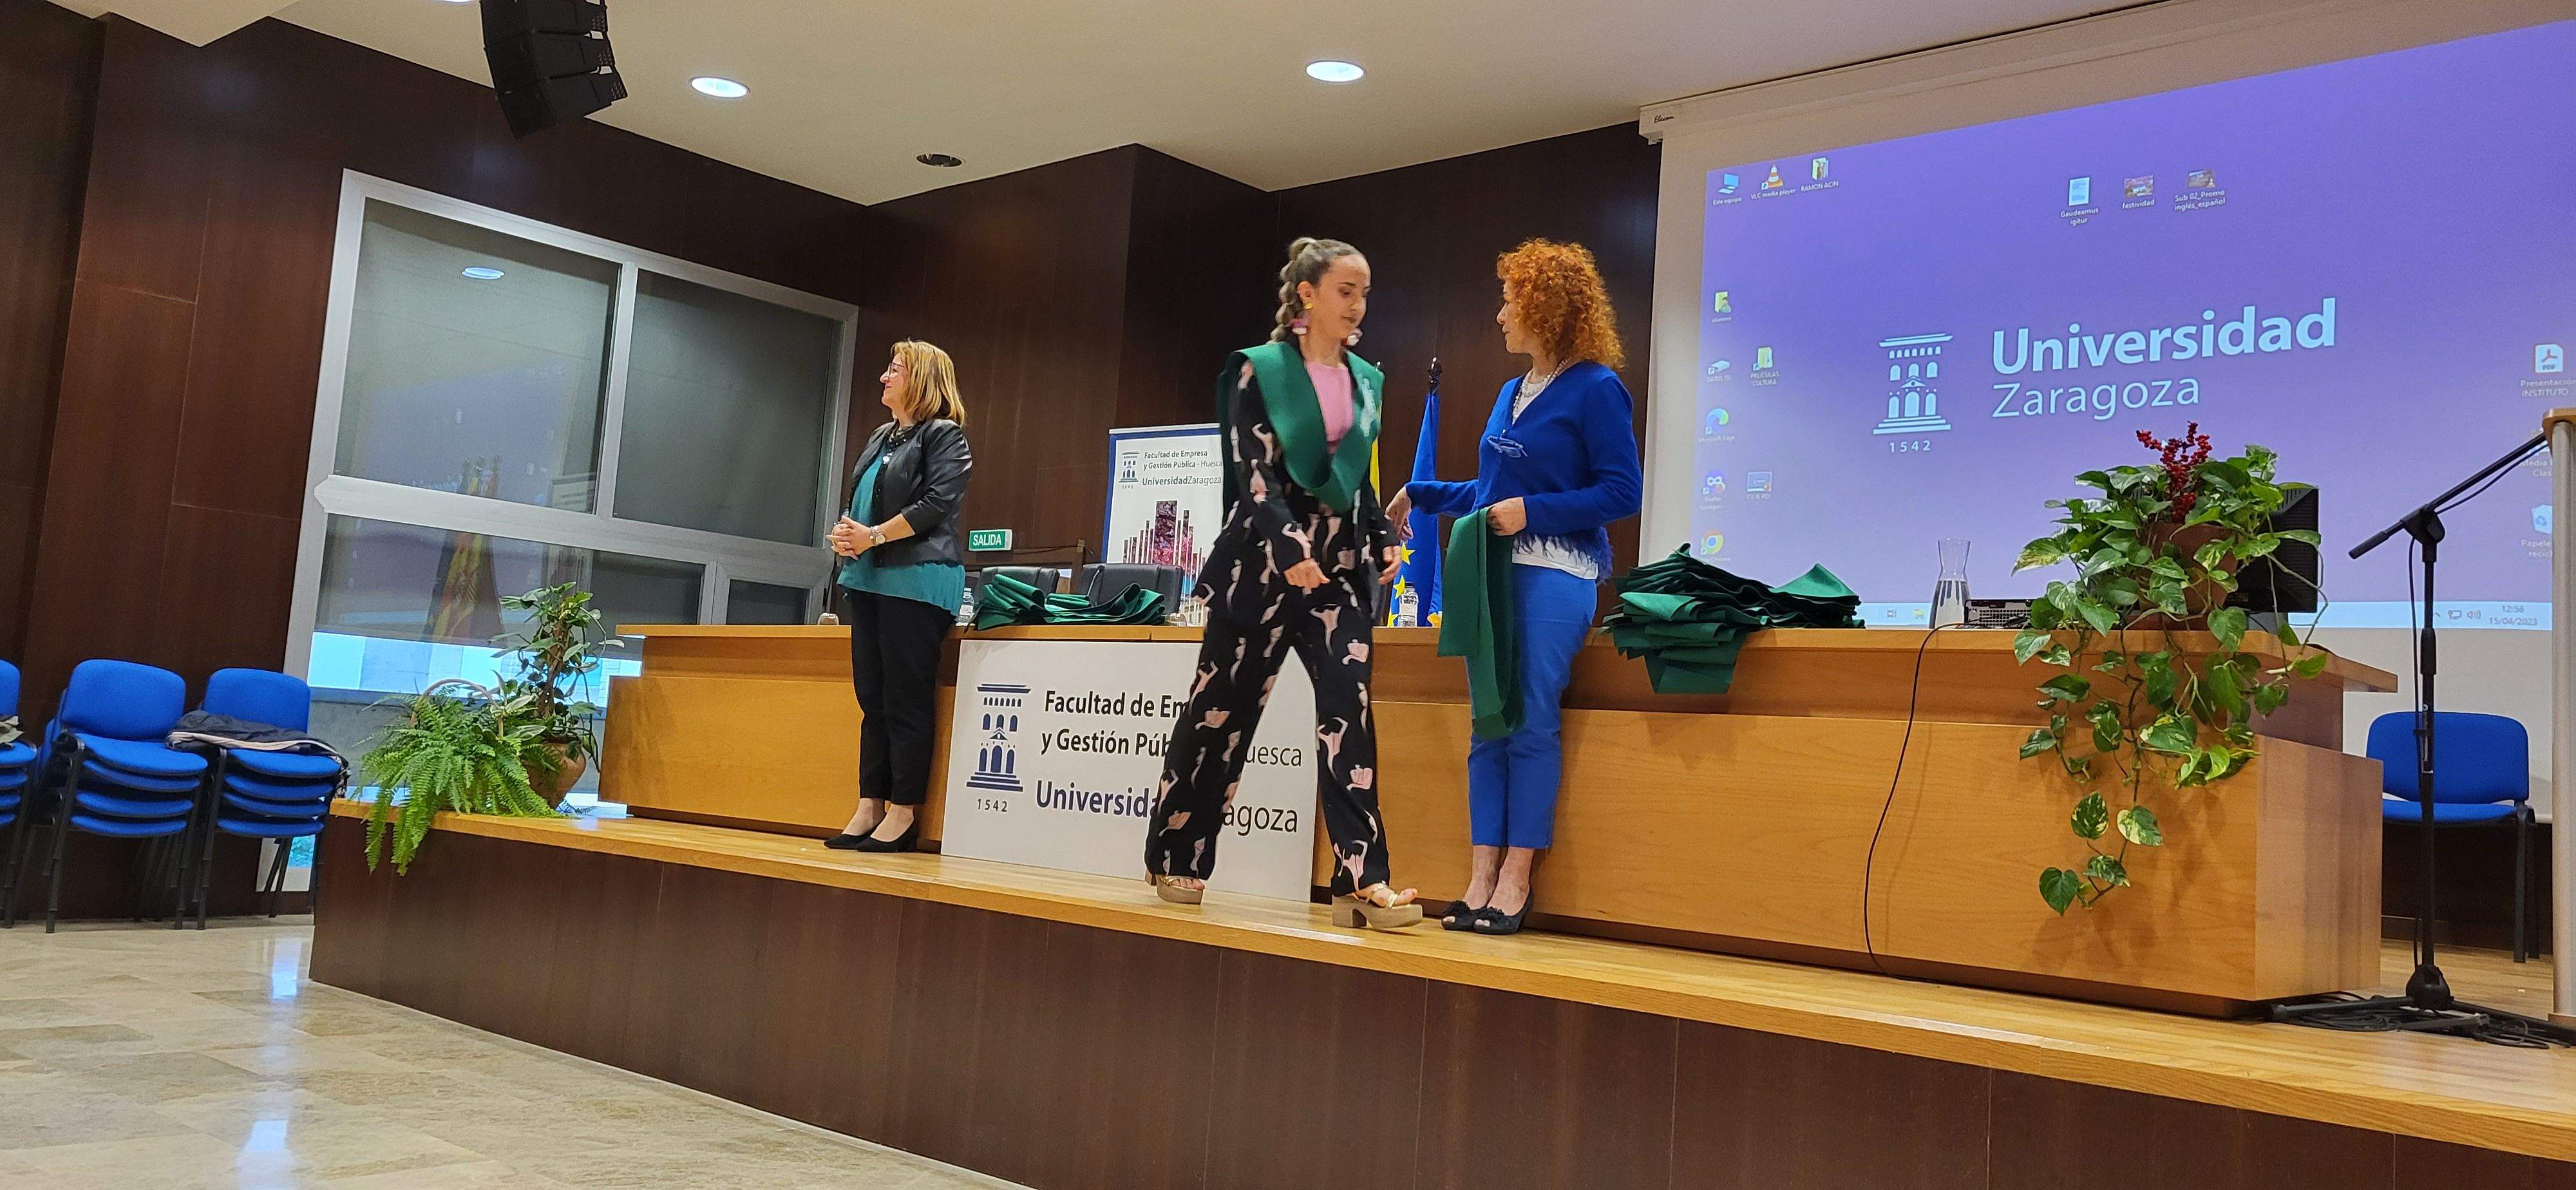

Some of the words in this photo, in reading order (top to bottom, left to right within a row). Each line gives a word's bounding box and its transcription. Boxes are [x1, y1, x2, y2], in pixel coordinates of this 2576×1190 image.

[1779, 187, 1796, 196] player
[1724, 196, 1742, 205] equipo
[2060, 207, 2099, 218] Gaudeamus
[2070, 218, 2088, 227] igitur
[1992, 297, 2336, 375] Universidad
[2522, 388, 2568, 397] INSTITUTO
[1992, 377, 2200, 420] Zaragoza
[1888, 439, 1931, 453] 1542
[972, 533, 1002, 547] SALIDA
[2521, 540, 2552, 549] Papele
[2528, 549, 2553, 558] recicl
[2489, 617, 2538, 626] 15/04/2023
[1045, 690, 1126, 715] Facultad
[1130, 693, 1155, 717] de
[1160, 695, 1188, 718] Em
[1041, 733, 1053, 755] y
[1057, 729, 1130, 755] Gestión
[1135, 733, 1171, 757] Púb
[1245, 746, 1302, 767] uesca
[976, 798, 1008, 813] 1542
